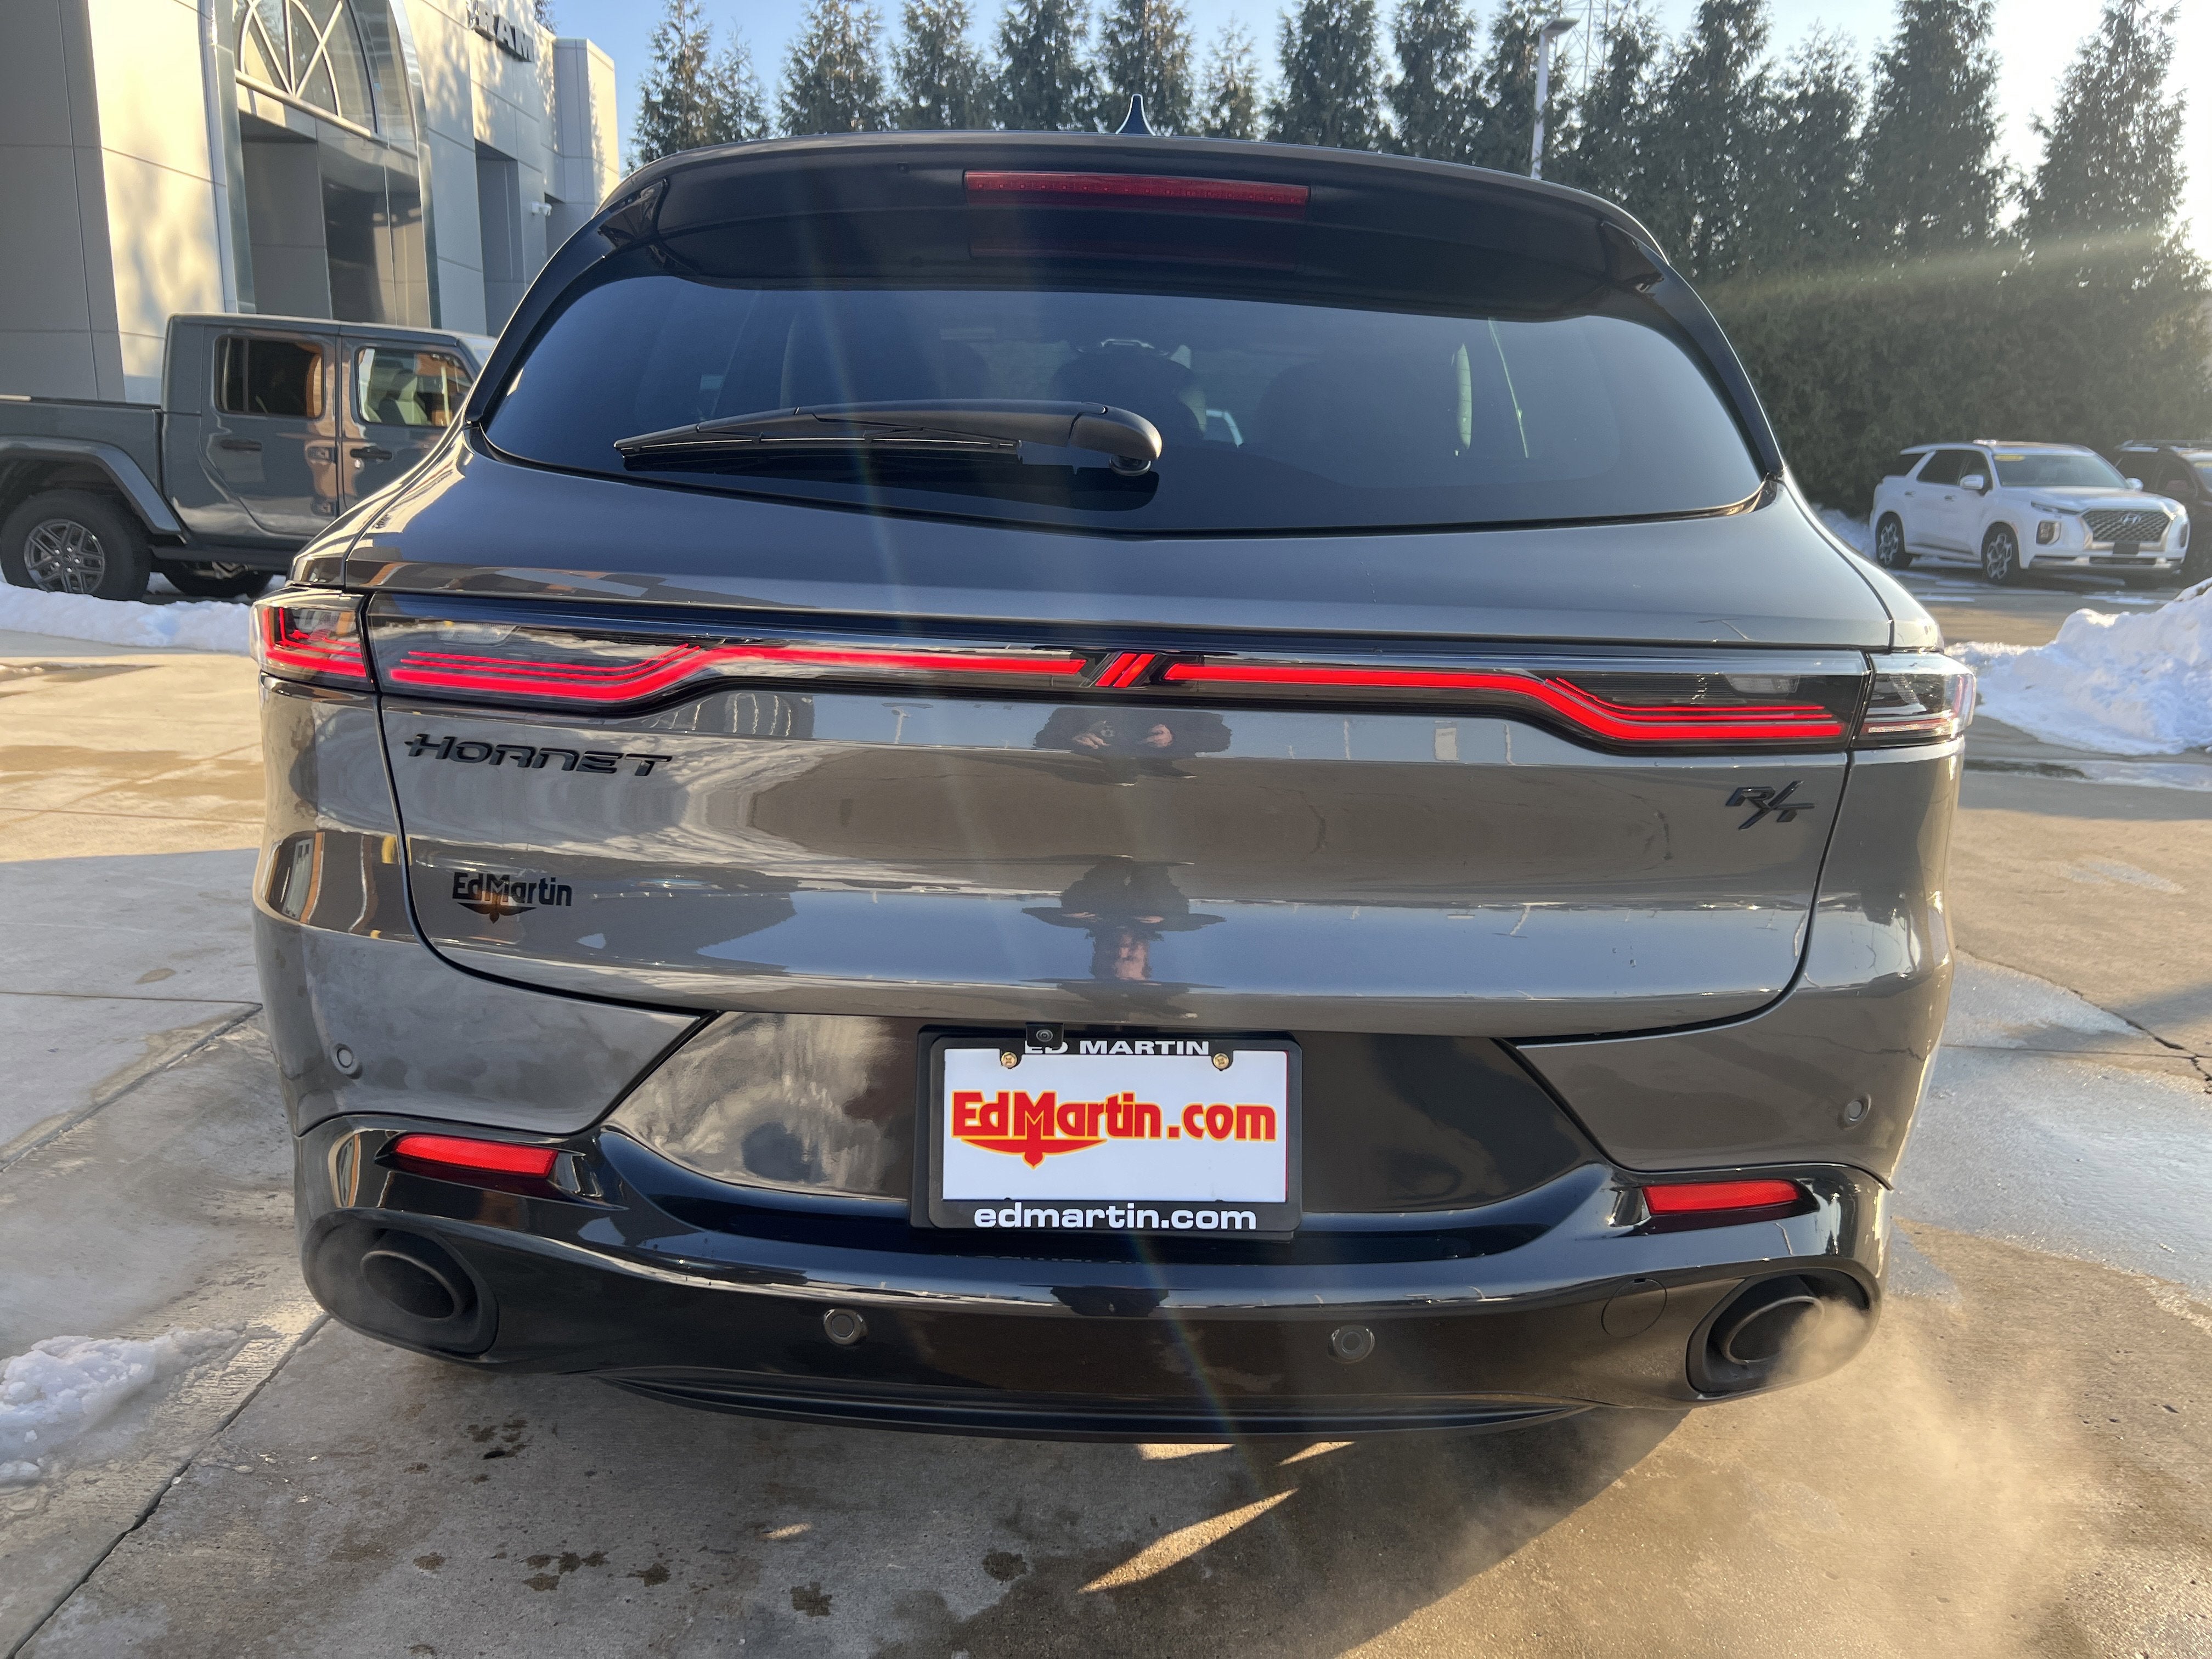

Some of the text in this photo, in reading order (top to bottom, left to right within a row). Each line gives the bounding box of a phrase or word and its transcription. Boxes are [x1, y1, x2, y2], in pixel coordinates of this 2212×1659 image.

[476, 1, 534, 63] RAM
[404, 733, 672, 776] HORNET
[1725, 781, 1815, 830] R/T
[453, 872, 572, 907] EdMartin
[1080, 1041, 1209, 1055] MARTIN
[952, 1090, 1277, 1142] EdMartin.com
[974, 1202, 1256, 1230] edmartin.com
